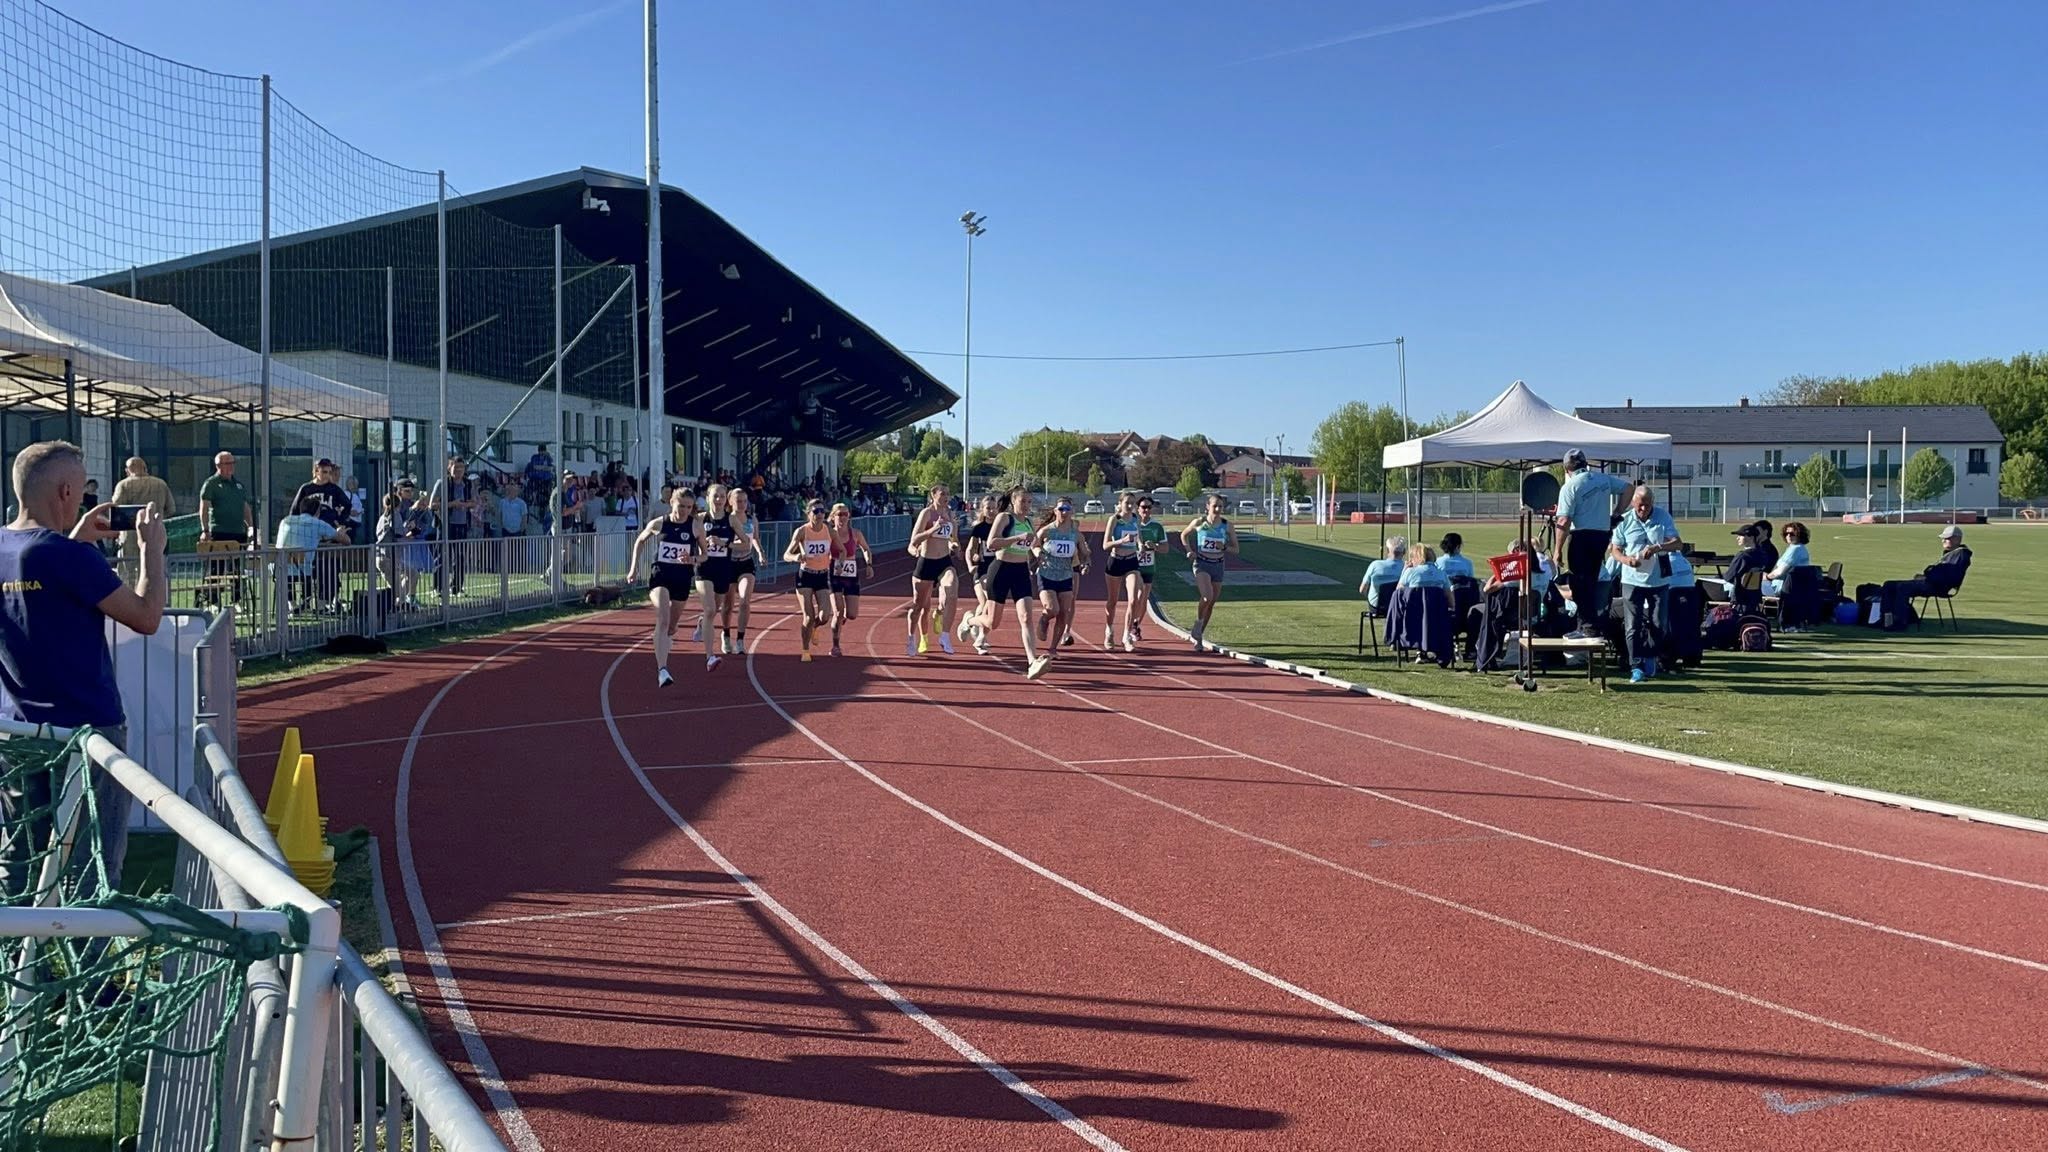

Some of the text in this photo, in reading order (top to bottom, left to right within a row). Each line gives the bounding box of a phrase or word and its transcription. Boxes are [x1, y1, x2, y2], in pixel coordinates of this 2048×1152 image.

[937, 524, 951, 536] 219
[808, 544, 825, 555] 213
[1056, 543, 1070, 554] 211
[1203, 539, 1220, 550] 23
[662, 546, 686, 559] 23
[1138, 553, 1152, 564] 215
[840, 563, 855, 574] 43
